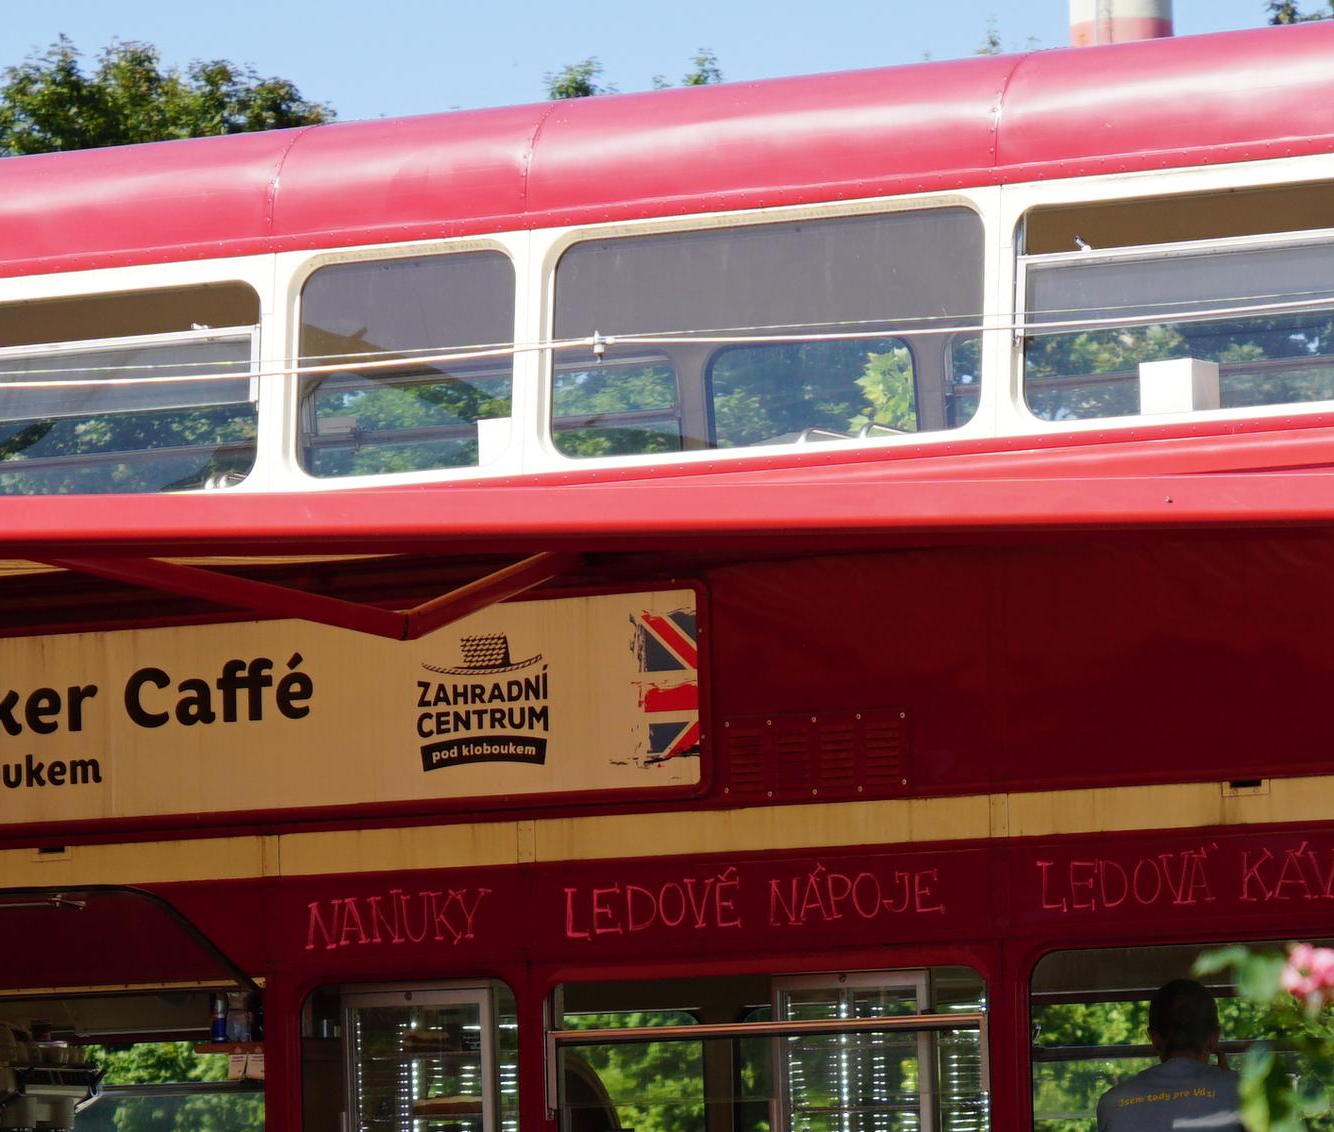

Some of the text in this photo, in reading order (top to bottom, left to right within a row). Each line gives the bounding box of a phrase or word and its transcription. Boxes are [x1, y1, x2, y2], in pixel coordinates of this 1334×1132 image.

[124, 652, 315, 728] Caffé
[417, 664, 548, 708] ZAHRADNÍ
[417, 706, 549, 739] CENTRUM
[432, 743, 536, 763] pod kloboukem
[564, 862, 946, 942] LEDOVÉ NÁPOJE
[1037, 842, 1219, 912] LEDOVÁ
[305, 888, 492, 950] NANUKY
